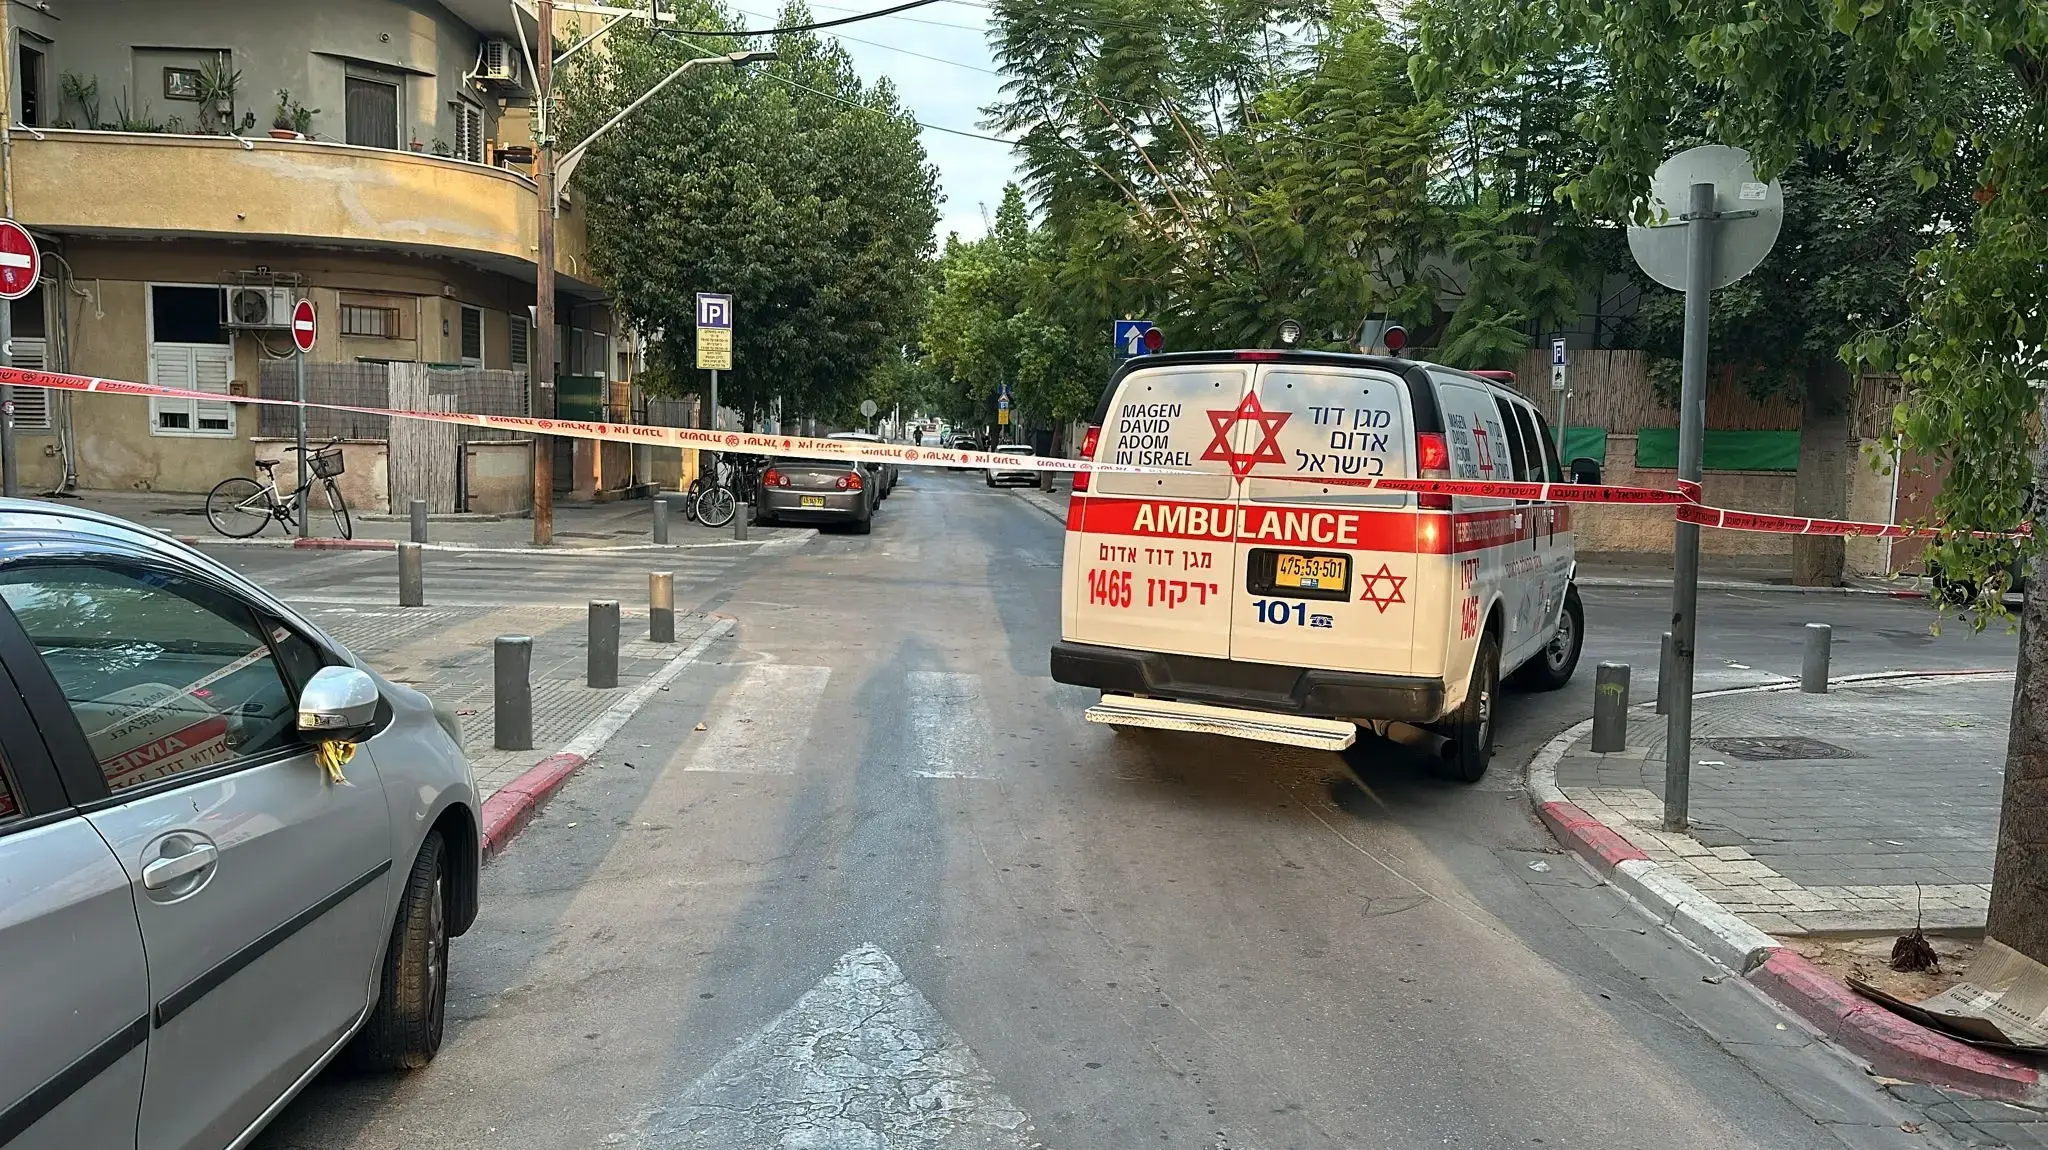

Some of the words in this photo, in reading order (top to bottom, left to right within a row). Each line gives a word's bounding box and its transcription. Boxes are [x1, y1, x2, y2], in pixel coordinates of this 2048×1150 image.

[709, 305, 721, 324] P
[40, 376, 85, 387] משטרת
[1122, 403, 1182, 418] MAGEN
[1308, 406, 1346, 426] דוד
[1353, 408, 1391, 431] מגן
[557, 422, 593, 433] ישראל
[613, 425, 630, 435] אין
[632, 427, 664, 438] מעבר
[1119, 419, 1170, 434] DAVID
[679, 431, 722, 443] משטרת
[743, 437, 778, 450] ישראל
[797, 440, 813, 449] אין
[1117, 434, 1169, 450] ADOM
[1330, 431, 1389, 453] אדום
[922, 451, 956, 463] ישראל
[975, 454, 990, 464] אין
[992, 456, 1021, 466] מעבר
[1116, 450, 1133, 465] IN
[1138, 451, 1193, 466] ISRAEL
[1295, 448, 1384, 477] בישראל
[1409, 483, 1425, 492] אין
[1445, 483, 1477, 492] ישראל
[1497, 486, 1537, 496] משטרת
[1552, 489, 1580, 497] מעבר
[1582, 490, 1597, 500] אין
[1616, 489, 1647, 500] ישראל
[1132, 503, 1360, 545] AMBULANCE
[1099, 542, 1137, 564] אדום
[1144, 547, 1175, 566] דוד
[1182, 551, 1213, 571] מגן
[1087, 568, 1132, 608] 1465
[1147, 578, 1218, 609] ירקון
[1252, 599, 1306, 626] 101
[1460, 595, 1479, 640] 1465
